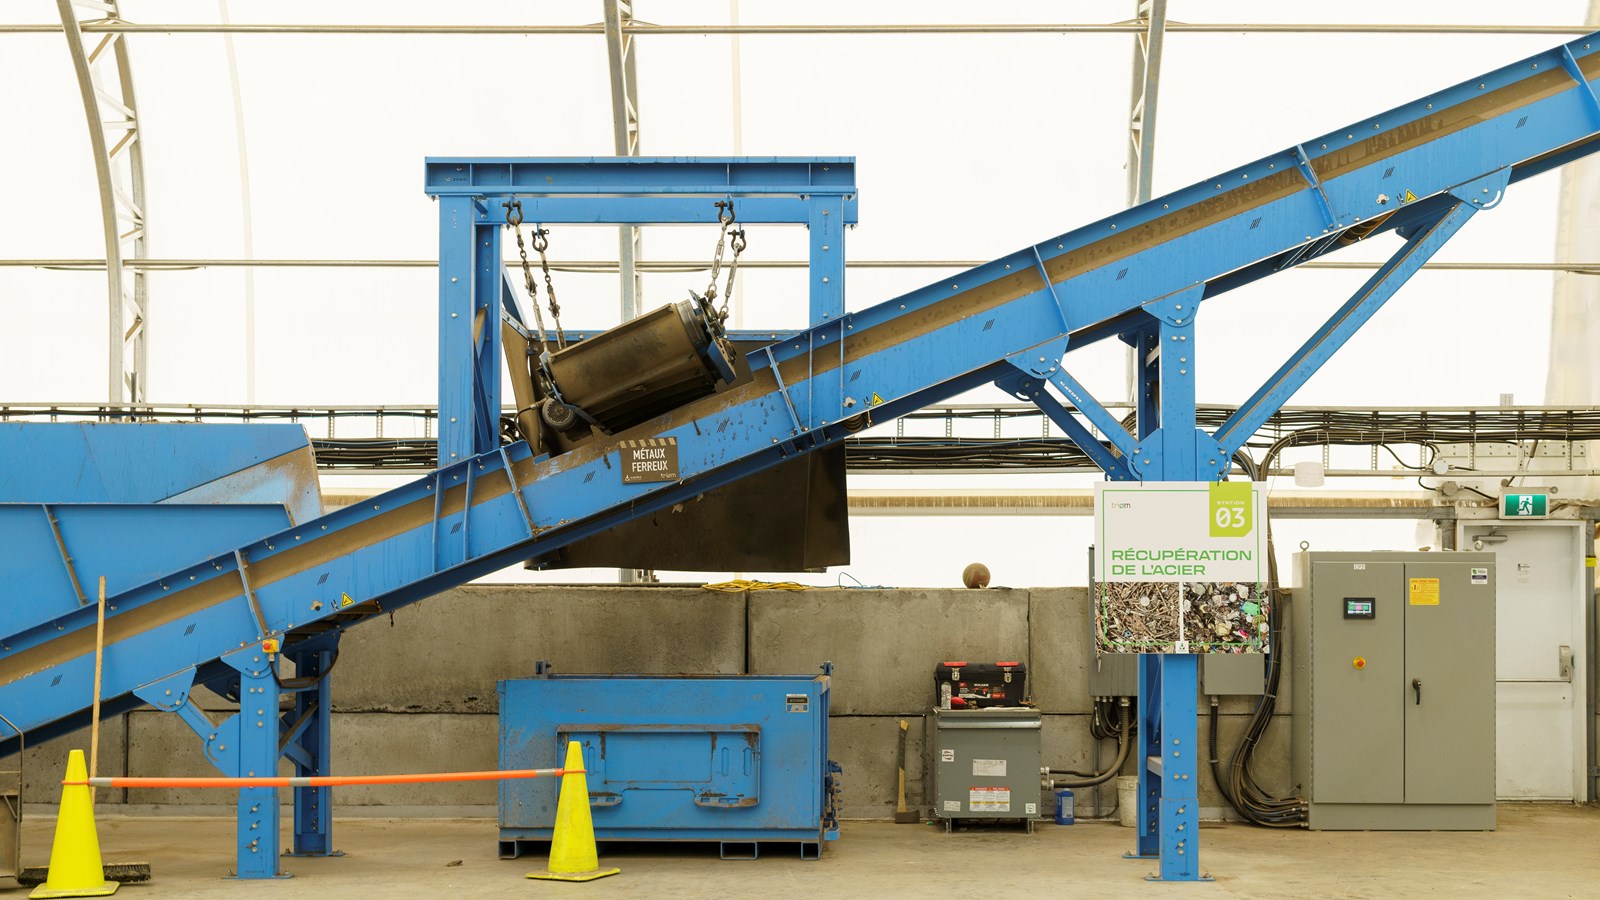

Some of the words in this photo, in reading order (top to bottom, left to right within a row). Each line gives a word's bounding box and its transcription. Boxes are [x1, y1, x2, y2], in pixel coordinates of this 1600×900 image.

[633, 447, 666, 460] MÉTAUX
[632, 460, 668, 473] FERREUX
[1215, 507, 1246, 528] 03
[1111, 548, 1252, 561] RÉCUPÉRATION
[1111, 564, 1136, 576] DE
[1141, 564, 1206, 576] L'ACIER
